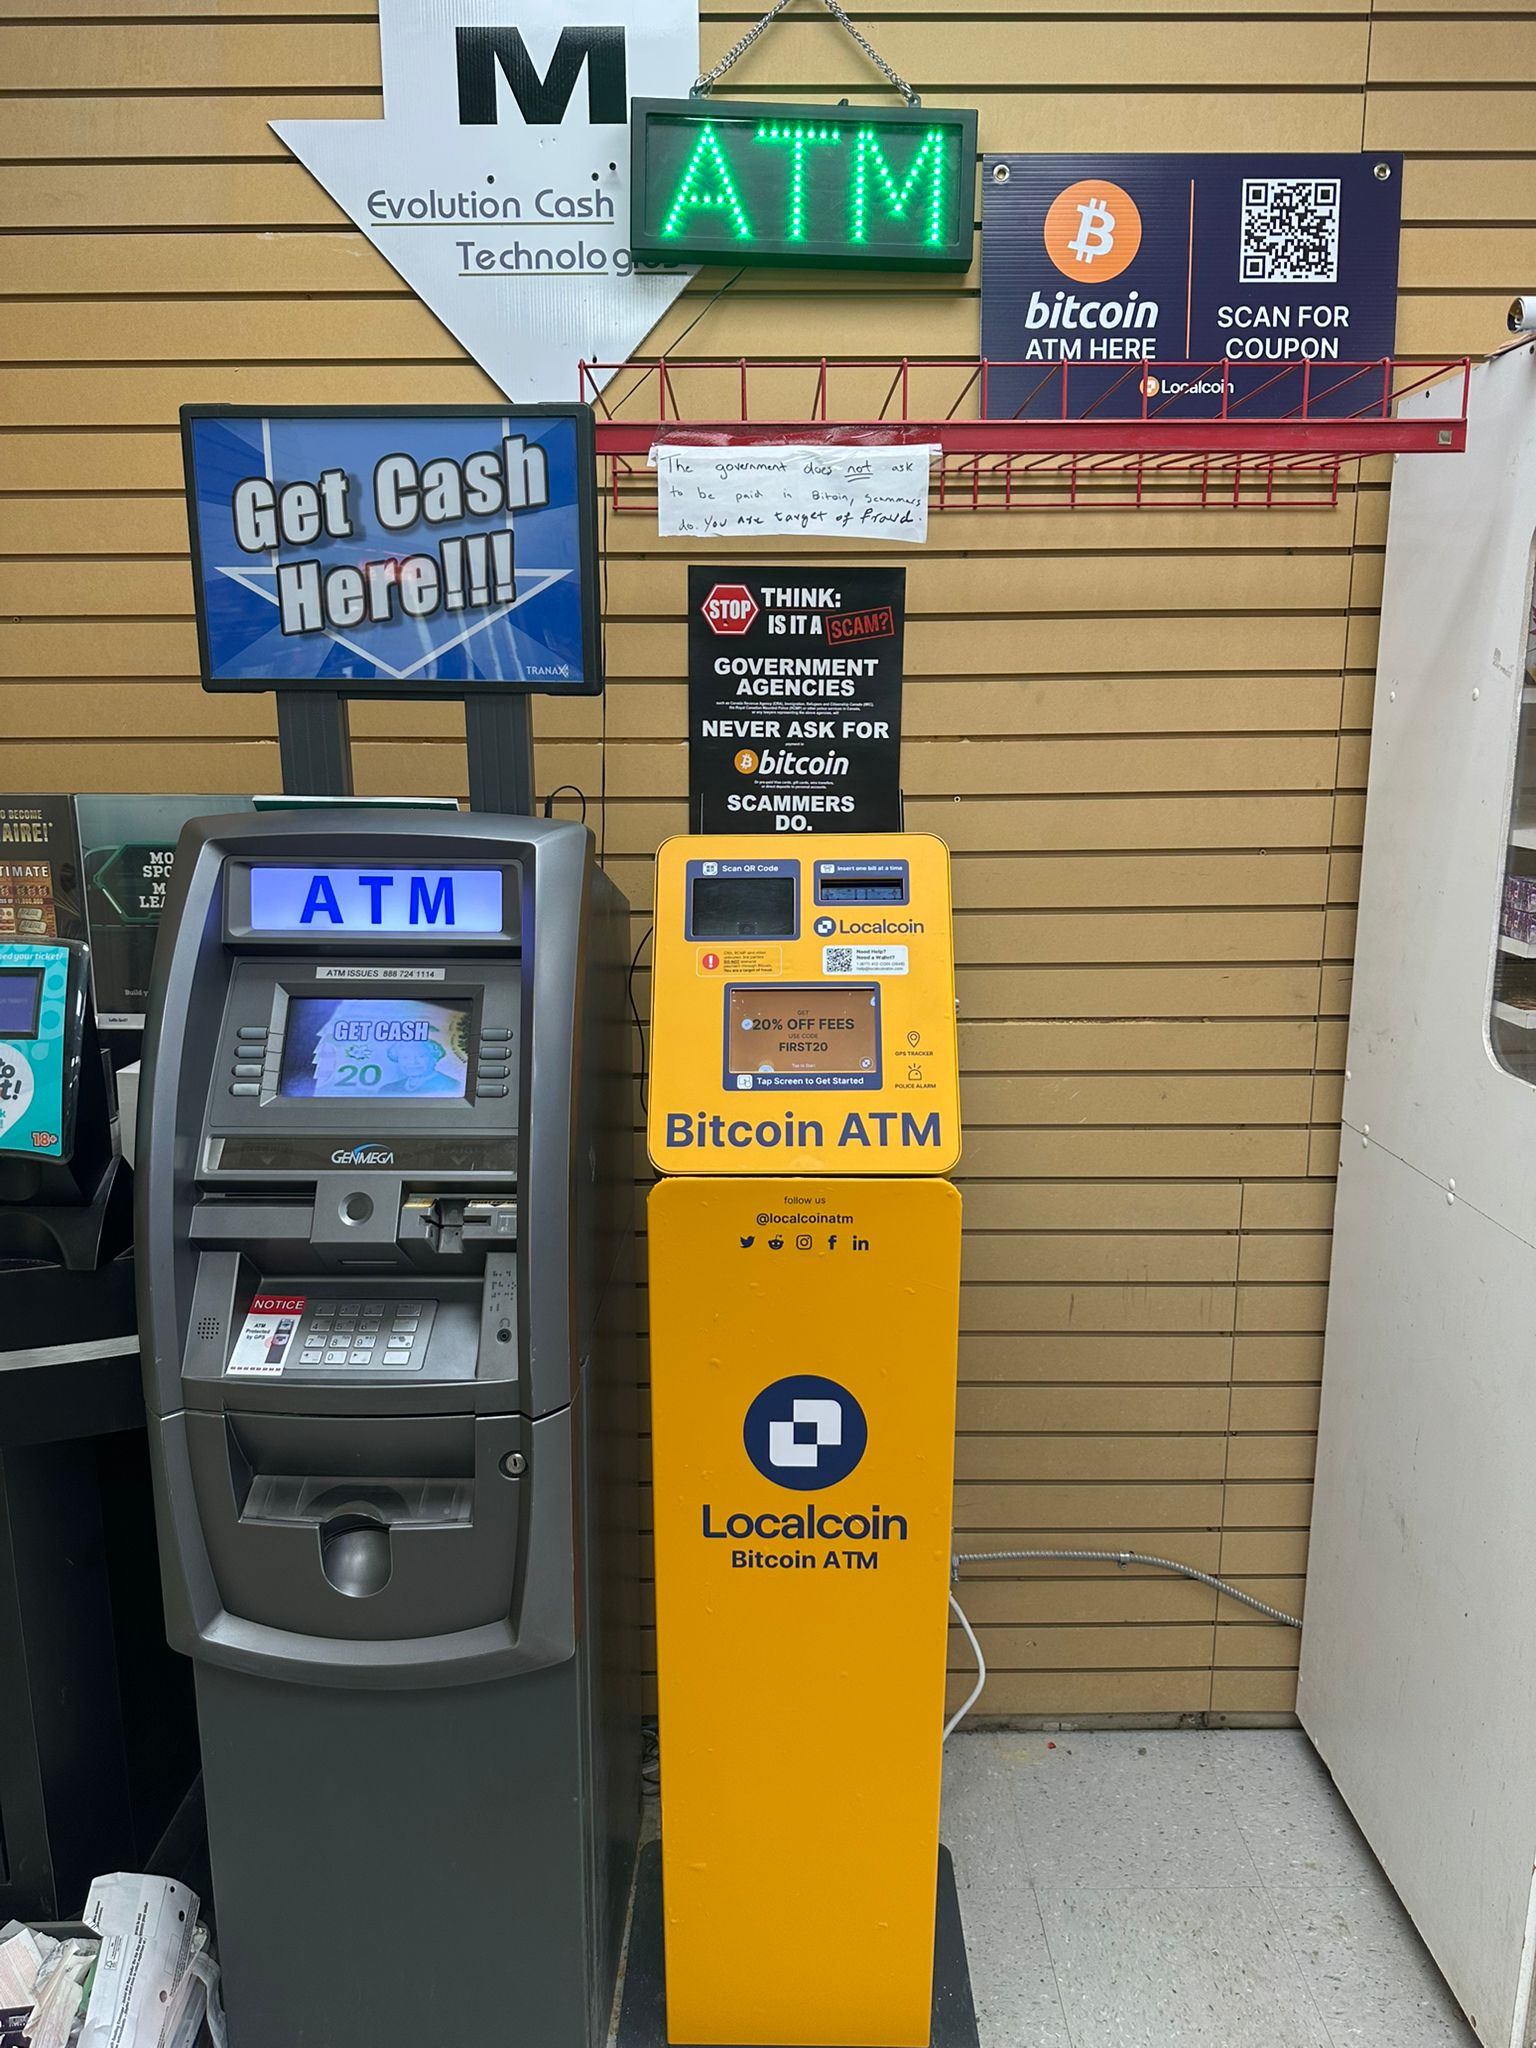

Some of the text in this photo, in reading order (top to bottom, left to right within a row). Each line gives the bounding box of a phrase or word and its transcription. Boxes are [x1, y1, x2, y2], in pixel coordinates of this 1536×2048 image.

[455, 26, 627, 125] M
[663, 121, 944, 244] ATM
[367, 189, 614, 219] Evolution Cash
[1024, 291, 1159, 329] bitcoin
[1217, 306, 1350, 328] SCAN FOR
[1025, 338, 1156, 360] ATM HERE
[1225, 337, 1339, 361] COUPON
[1161, 379, 1234, 394] Localcoin
[661, 455, 913, 480] The government does not ask
[233, 433, 550, 553] Get Cash
[670, 486, 683, 497] to
[697, 487, 715, 500] be
[736, 490, 763, 503] paid
[783, 488, 792, 499] in
[775, 511, 827, 528] target
[835, 512, 854, 527] of
[276, 529, 516, 637] Here!!!
[761, 587, 841, 608] THINK:
[709, 599, 751, 620] STOP
[768, 614, 823, 635] IS IT A
[831, 613, 889, 640] SCAM?
[714, 658, 879, 677] GOVERNMENT
[736, 679, 855, 697] AGENCIES
[702, 720, 890, 739] NEVER ASK FOR
[758, 749, 850, 775] bitcoin
[727, 795, 856, 812] SCAMMERS
[775, 815, 813, 832] DO.
[299, 875, 455, 925] ATM
[839, 918, 925, 935] Localcoin
[327, 969, 345, 977] ATM
[334, 1020, 430, 1041] GET CASH
[752, 1018, 855, 1031] 20% OFF FEES
[779, 1042, 828, 1052] FIRST20
[334, 1064, 382, 1087] 20
[756, 1077, 772, 1086] Tap
[774, 1077, 801, 1085] Screen
[816, 1077, 830, 1085] Get
[832, 1077, 864, 1085] Started
[31, 1131, 58, 1148] 18+
[666, 1111, 942, 1148] Bitcoin ATM
[784, 1196, 812, 1205] follow
[756, 1212, 854, 1226] @localcoinatm
[254, 1299, 305, 1310] NOTICE
[702, 1504, 908, 1541] Localcoin
[731, 1550, 878, 1570] Bitcoin ATM
